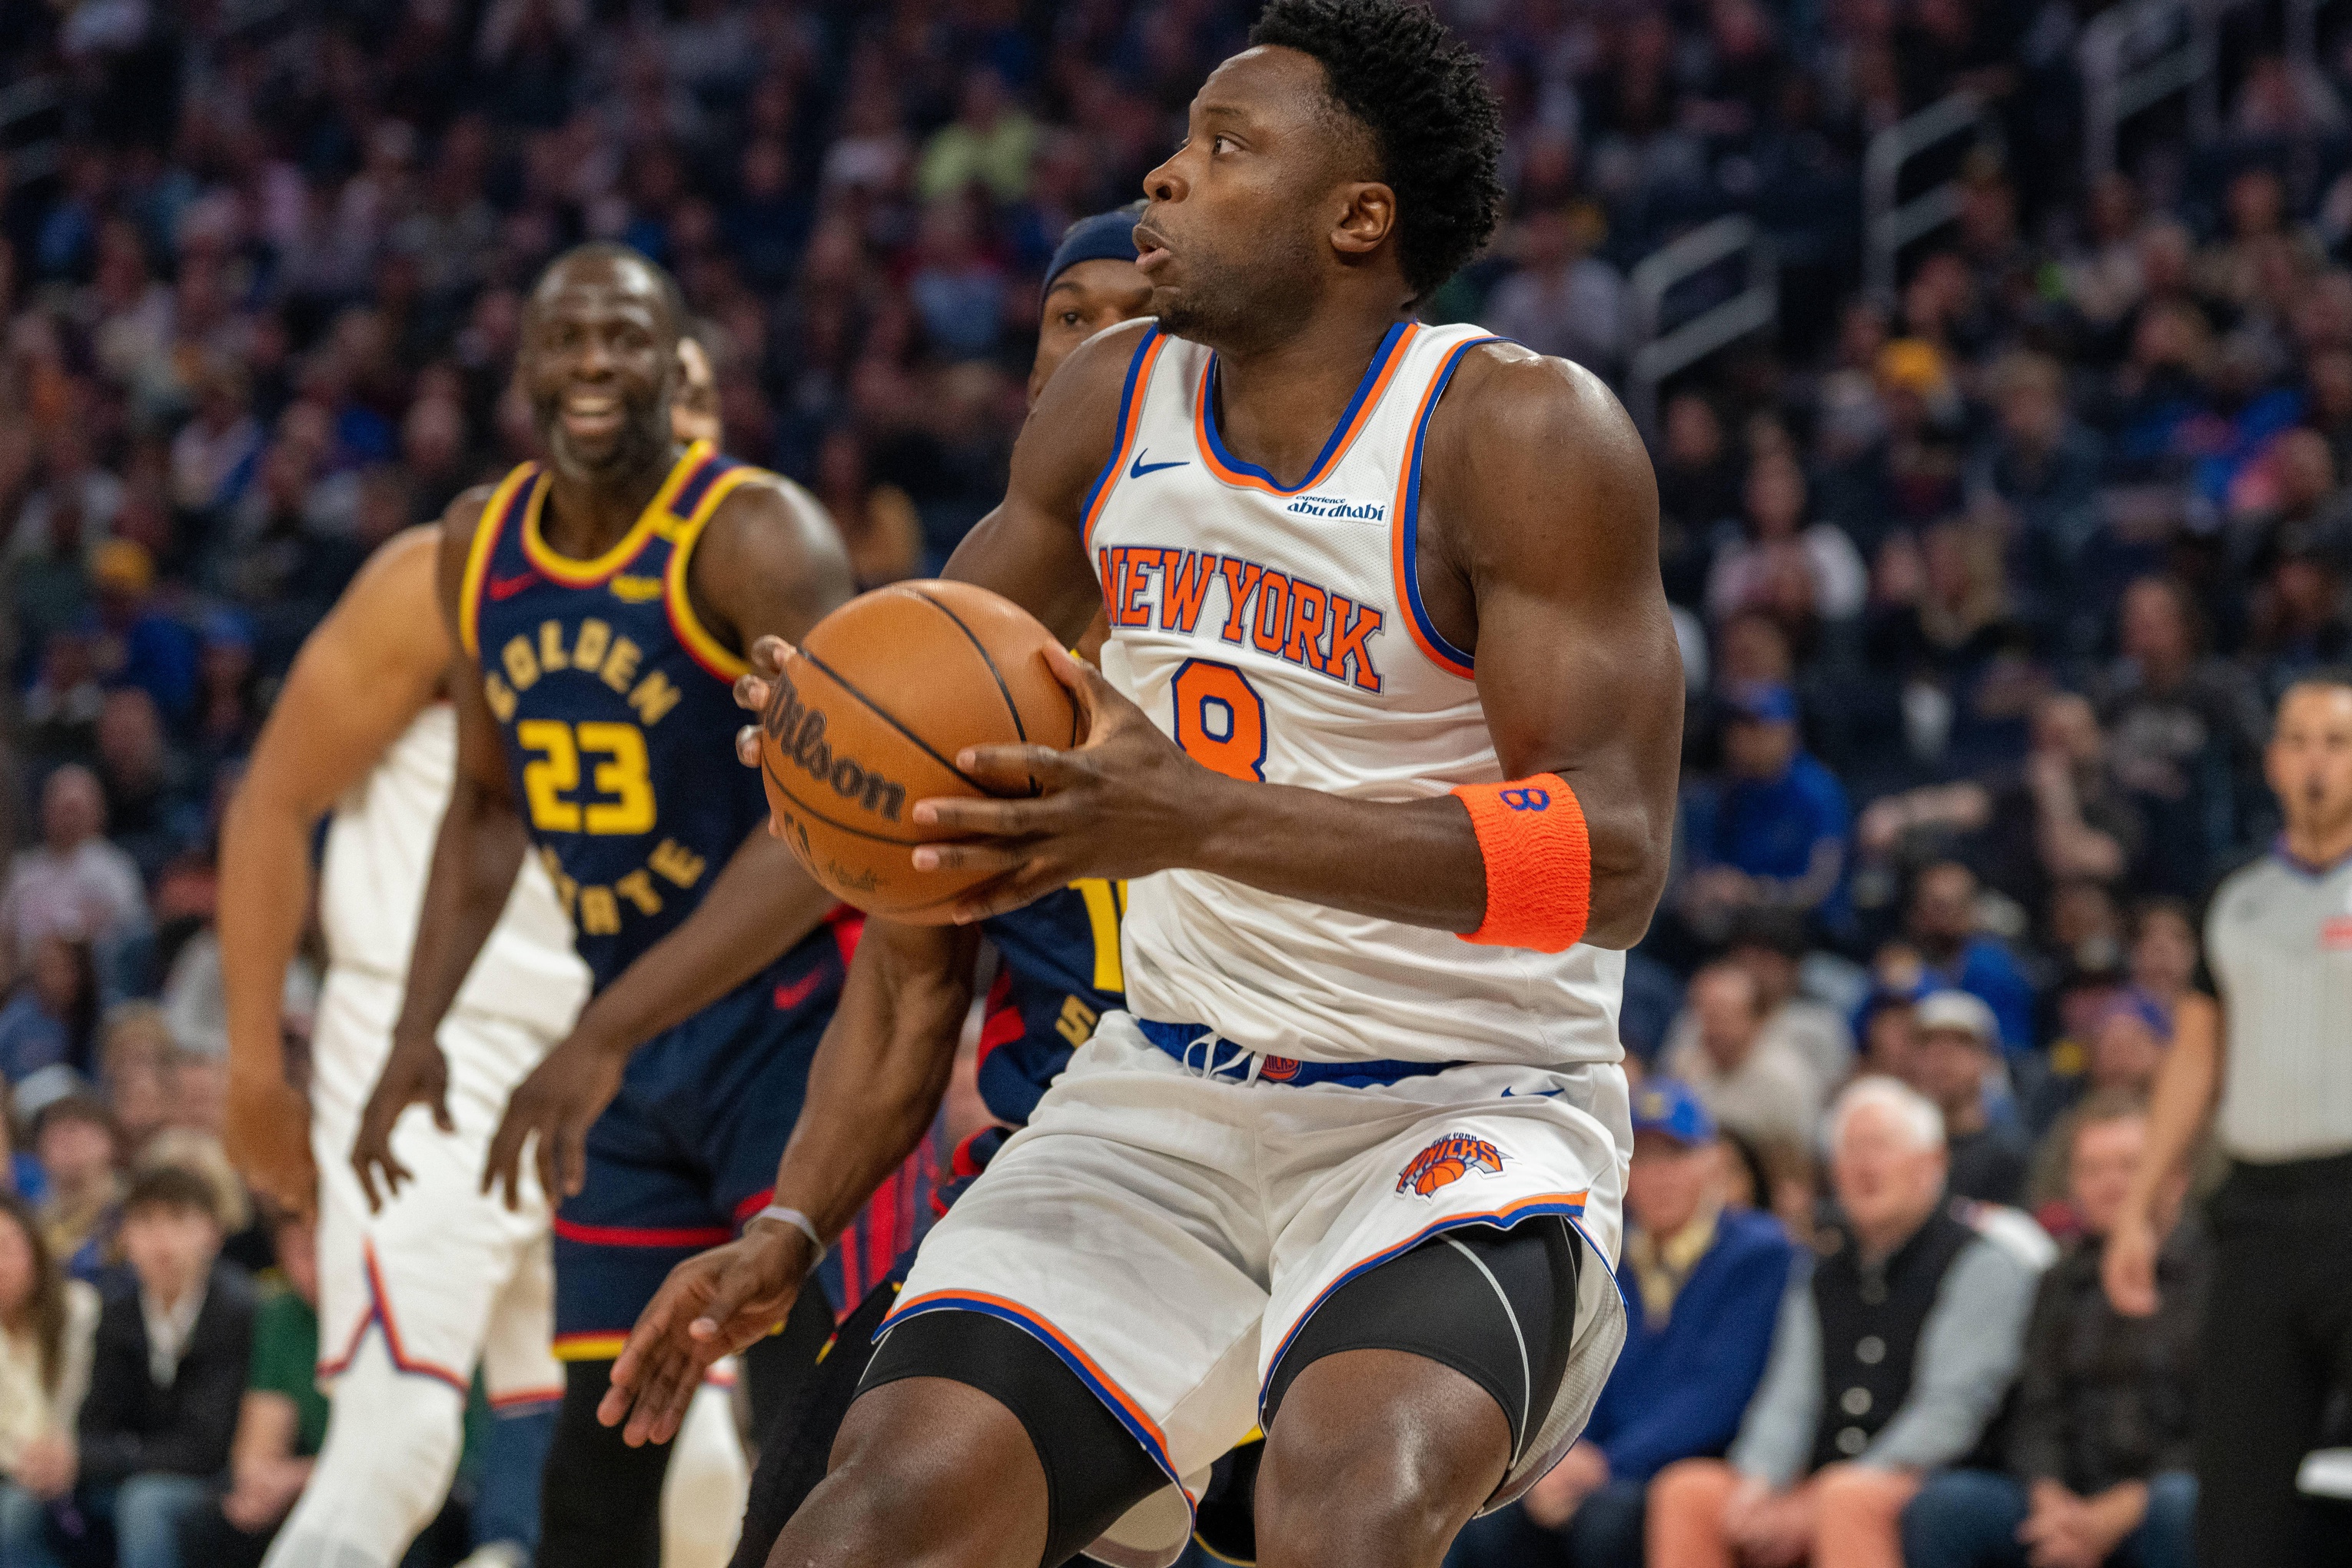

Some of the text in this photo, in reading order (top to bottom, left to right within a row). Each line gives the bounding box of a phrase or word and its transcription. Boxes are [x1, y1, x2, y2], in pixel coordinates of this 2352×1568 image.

[1287, 501, 1386, 522] abu dhabi
[1295, 495, 1346, 504] experience
[1098, 546, 1384, 694] NEW YORK
[767, 669, 905, 822] Wilson
[517, 719, 657, 835] 23
[1453, 1132, 1477, 1141] YORK
[1396, 1139, 1503, 1191] KNICKS
